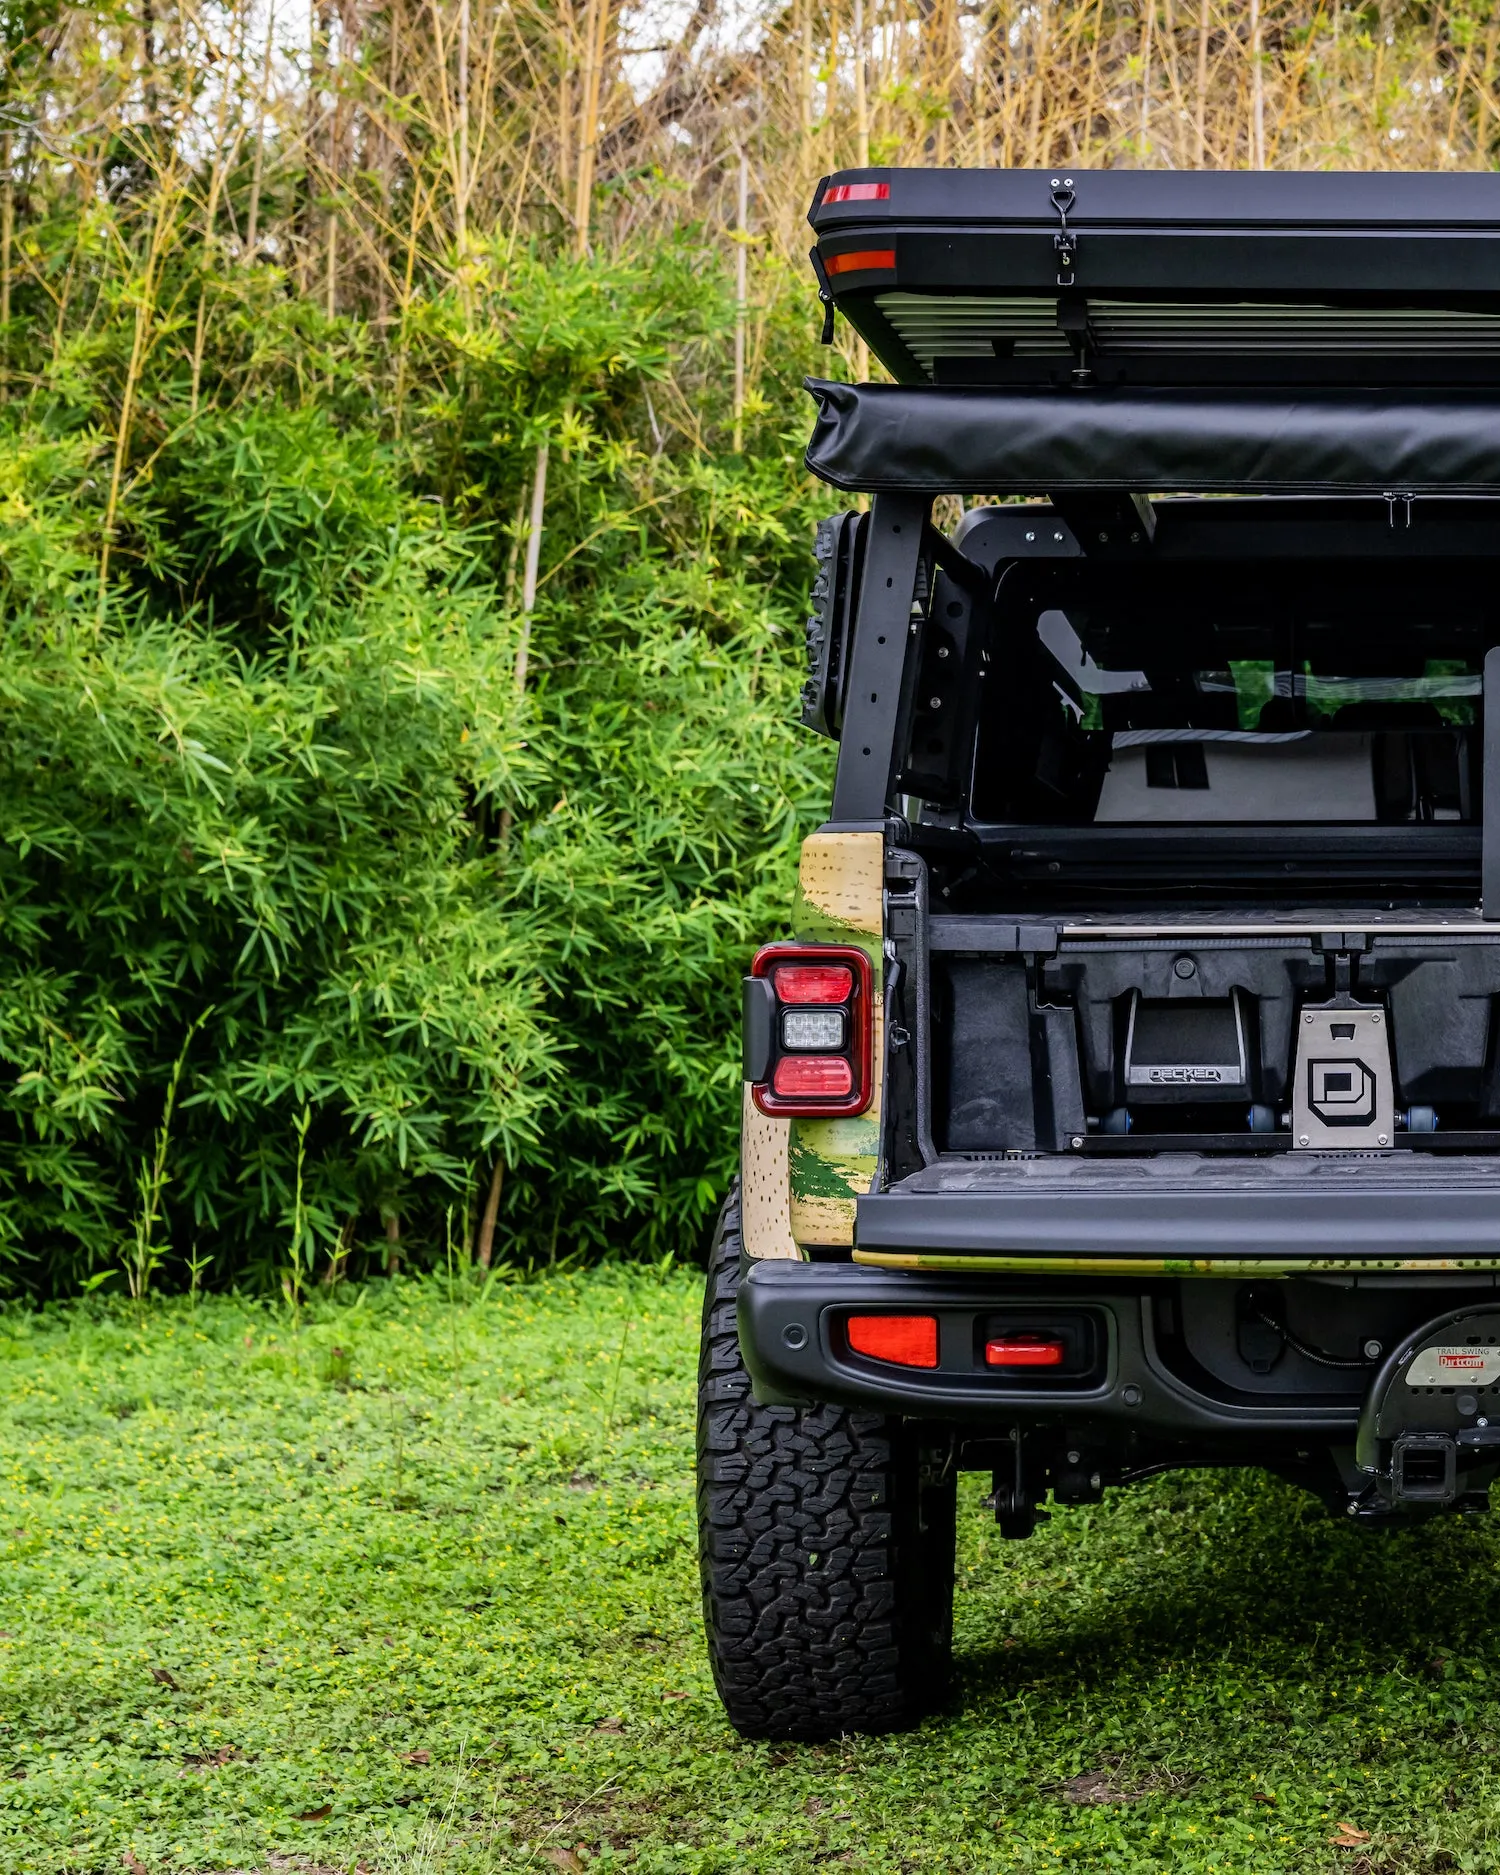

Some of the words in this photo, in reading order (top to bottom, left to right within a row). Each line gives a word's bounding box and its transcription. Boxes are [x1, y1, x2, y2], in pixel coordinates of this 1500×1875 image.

[1149, 1068, 1222, 1083] DECKED
[1436, 1347, 1459, 1355] TRAIL
[1461, 1347, 1490, 1355] SWING
